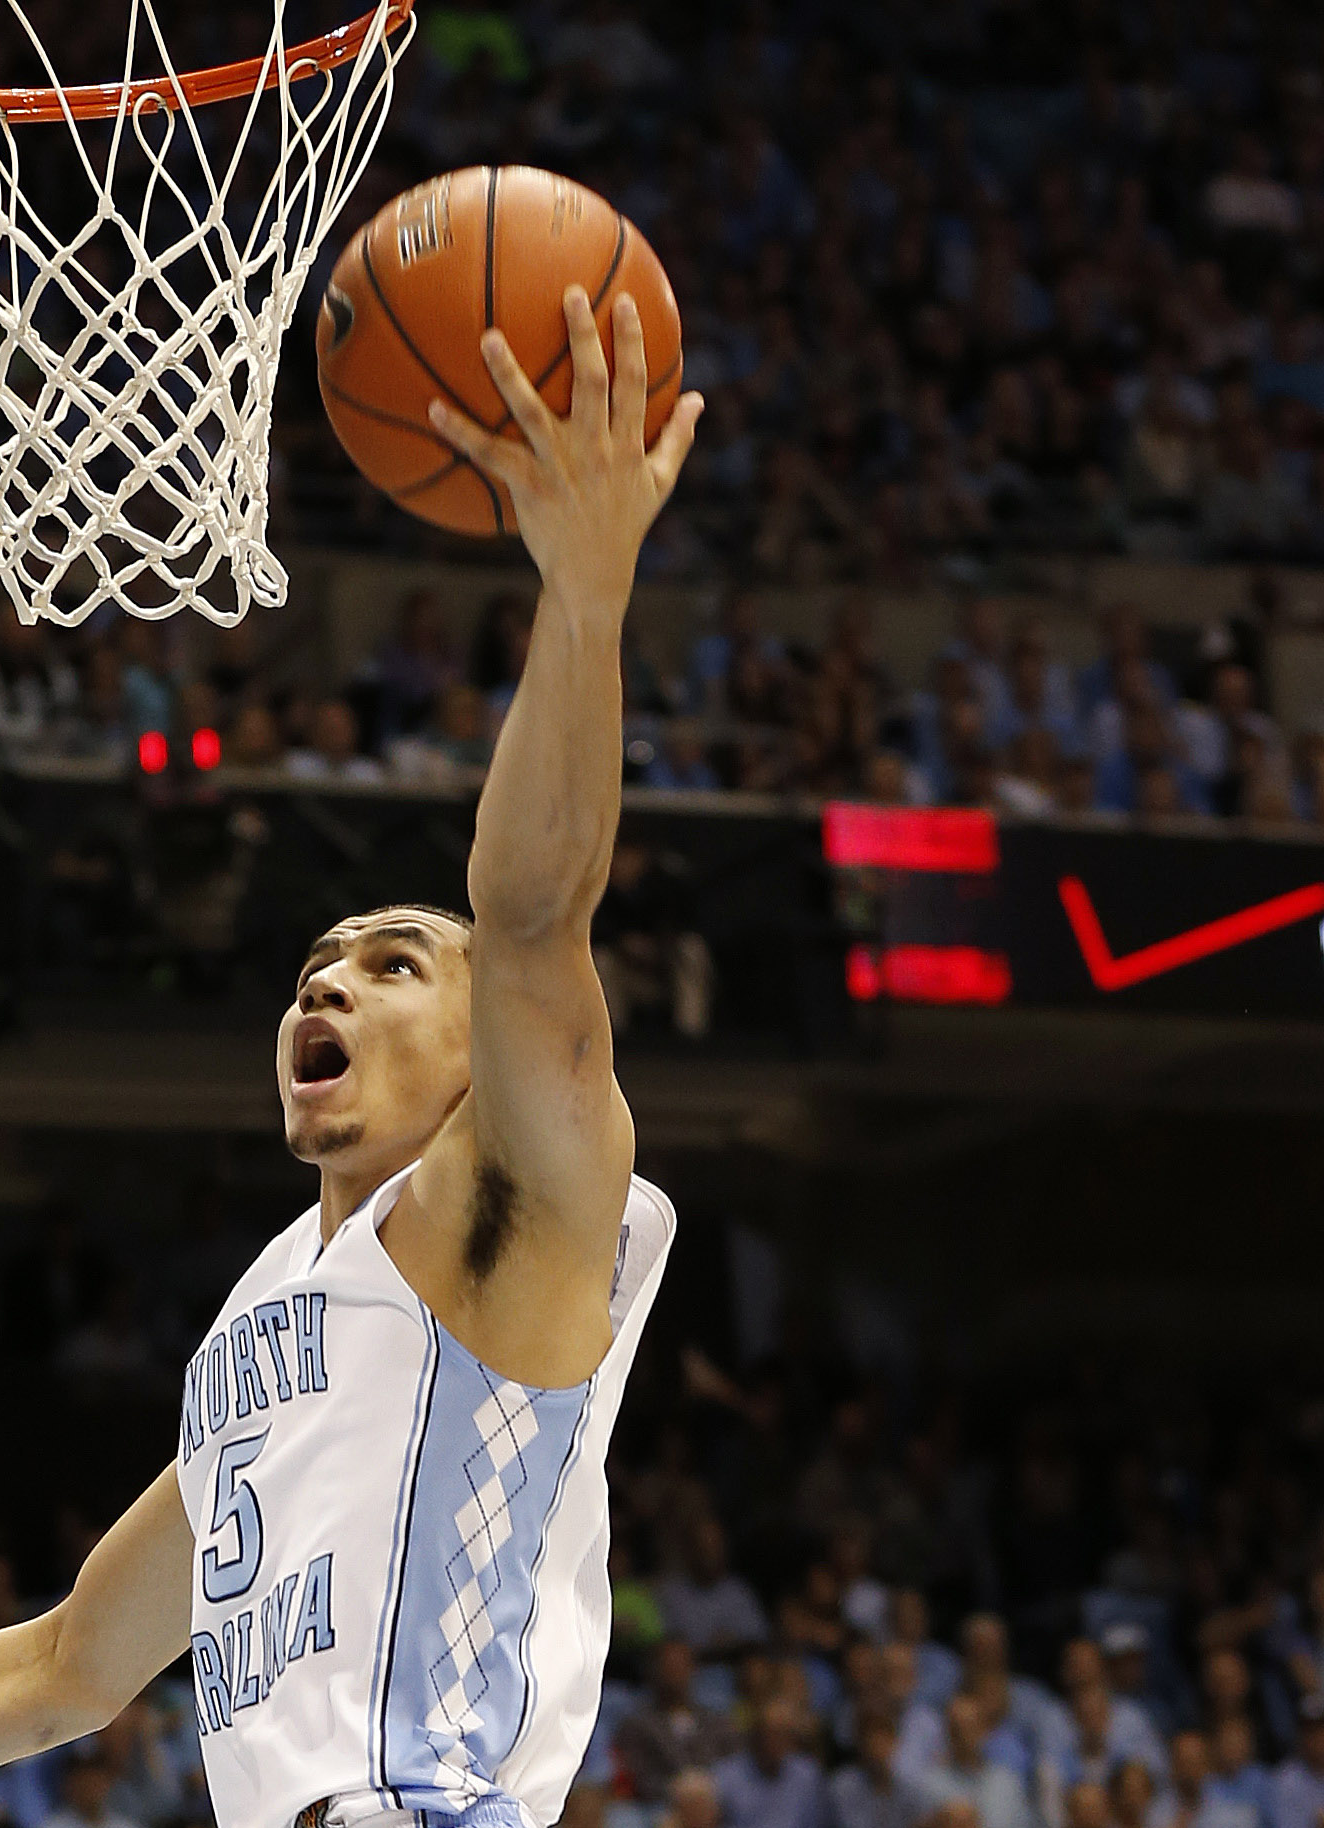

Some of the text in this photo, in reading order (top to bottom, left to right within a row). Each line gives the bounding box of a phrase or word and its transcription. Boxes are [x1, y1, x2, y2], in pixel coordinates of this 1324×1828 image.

[181, 1293, 328, 1466] NORTH
[201, 1421, 273, 1604] 5
[190, 1552, 335, 1736] ROLINA
